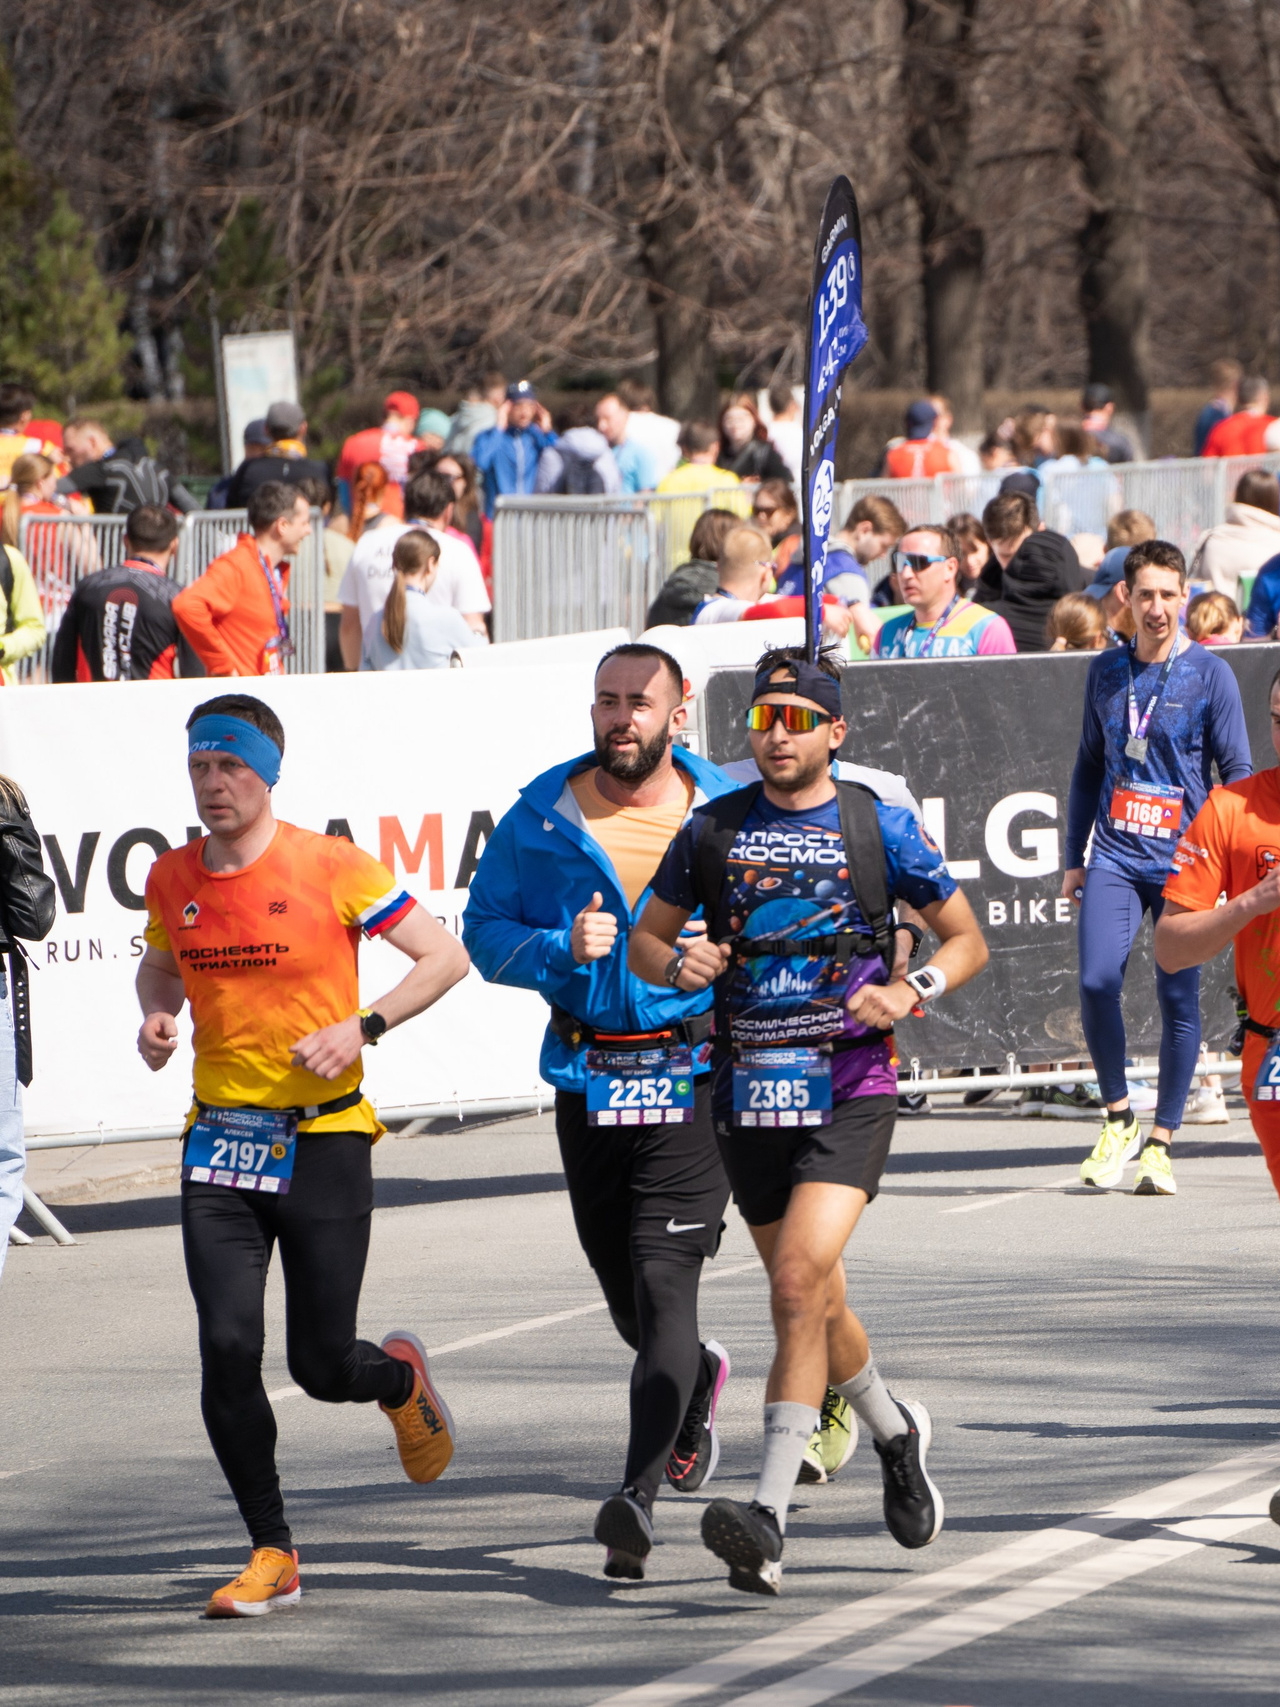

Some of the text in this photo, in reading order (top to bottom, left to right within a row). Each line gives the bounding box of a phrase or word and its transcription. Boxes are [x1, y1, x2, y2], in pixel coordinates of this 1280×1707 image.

[820, 213, 848, 265] GARMIN
[818, 254, 848, 348] 1:39
[103, 600, 120, 681] SAMARA
[119, 601, 137, 652] CLUB
[1126, 801, 1162, 825] 1168
[988, 898, 1071, 925] BIKE
[180, 943, 290, 961] РОСНЕФТЬ
[190, 957, 277, 972] ТРИАТЛОН
[609, 1078, 673, 1108] 2252
[748, 1079, 810, 1109] 2385
[224, 1128, 254, 1138] АЛЕКСЕЙ
[210, 1138, 270, 1172] 2197
[416, 1390, 443, 1436] HOKA
